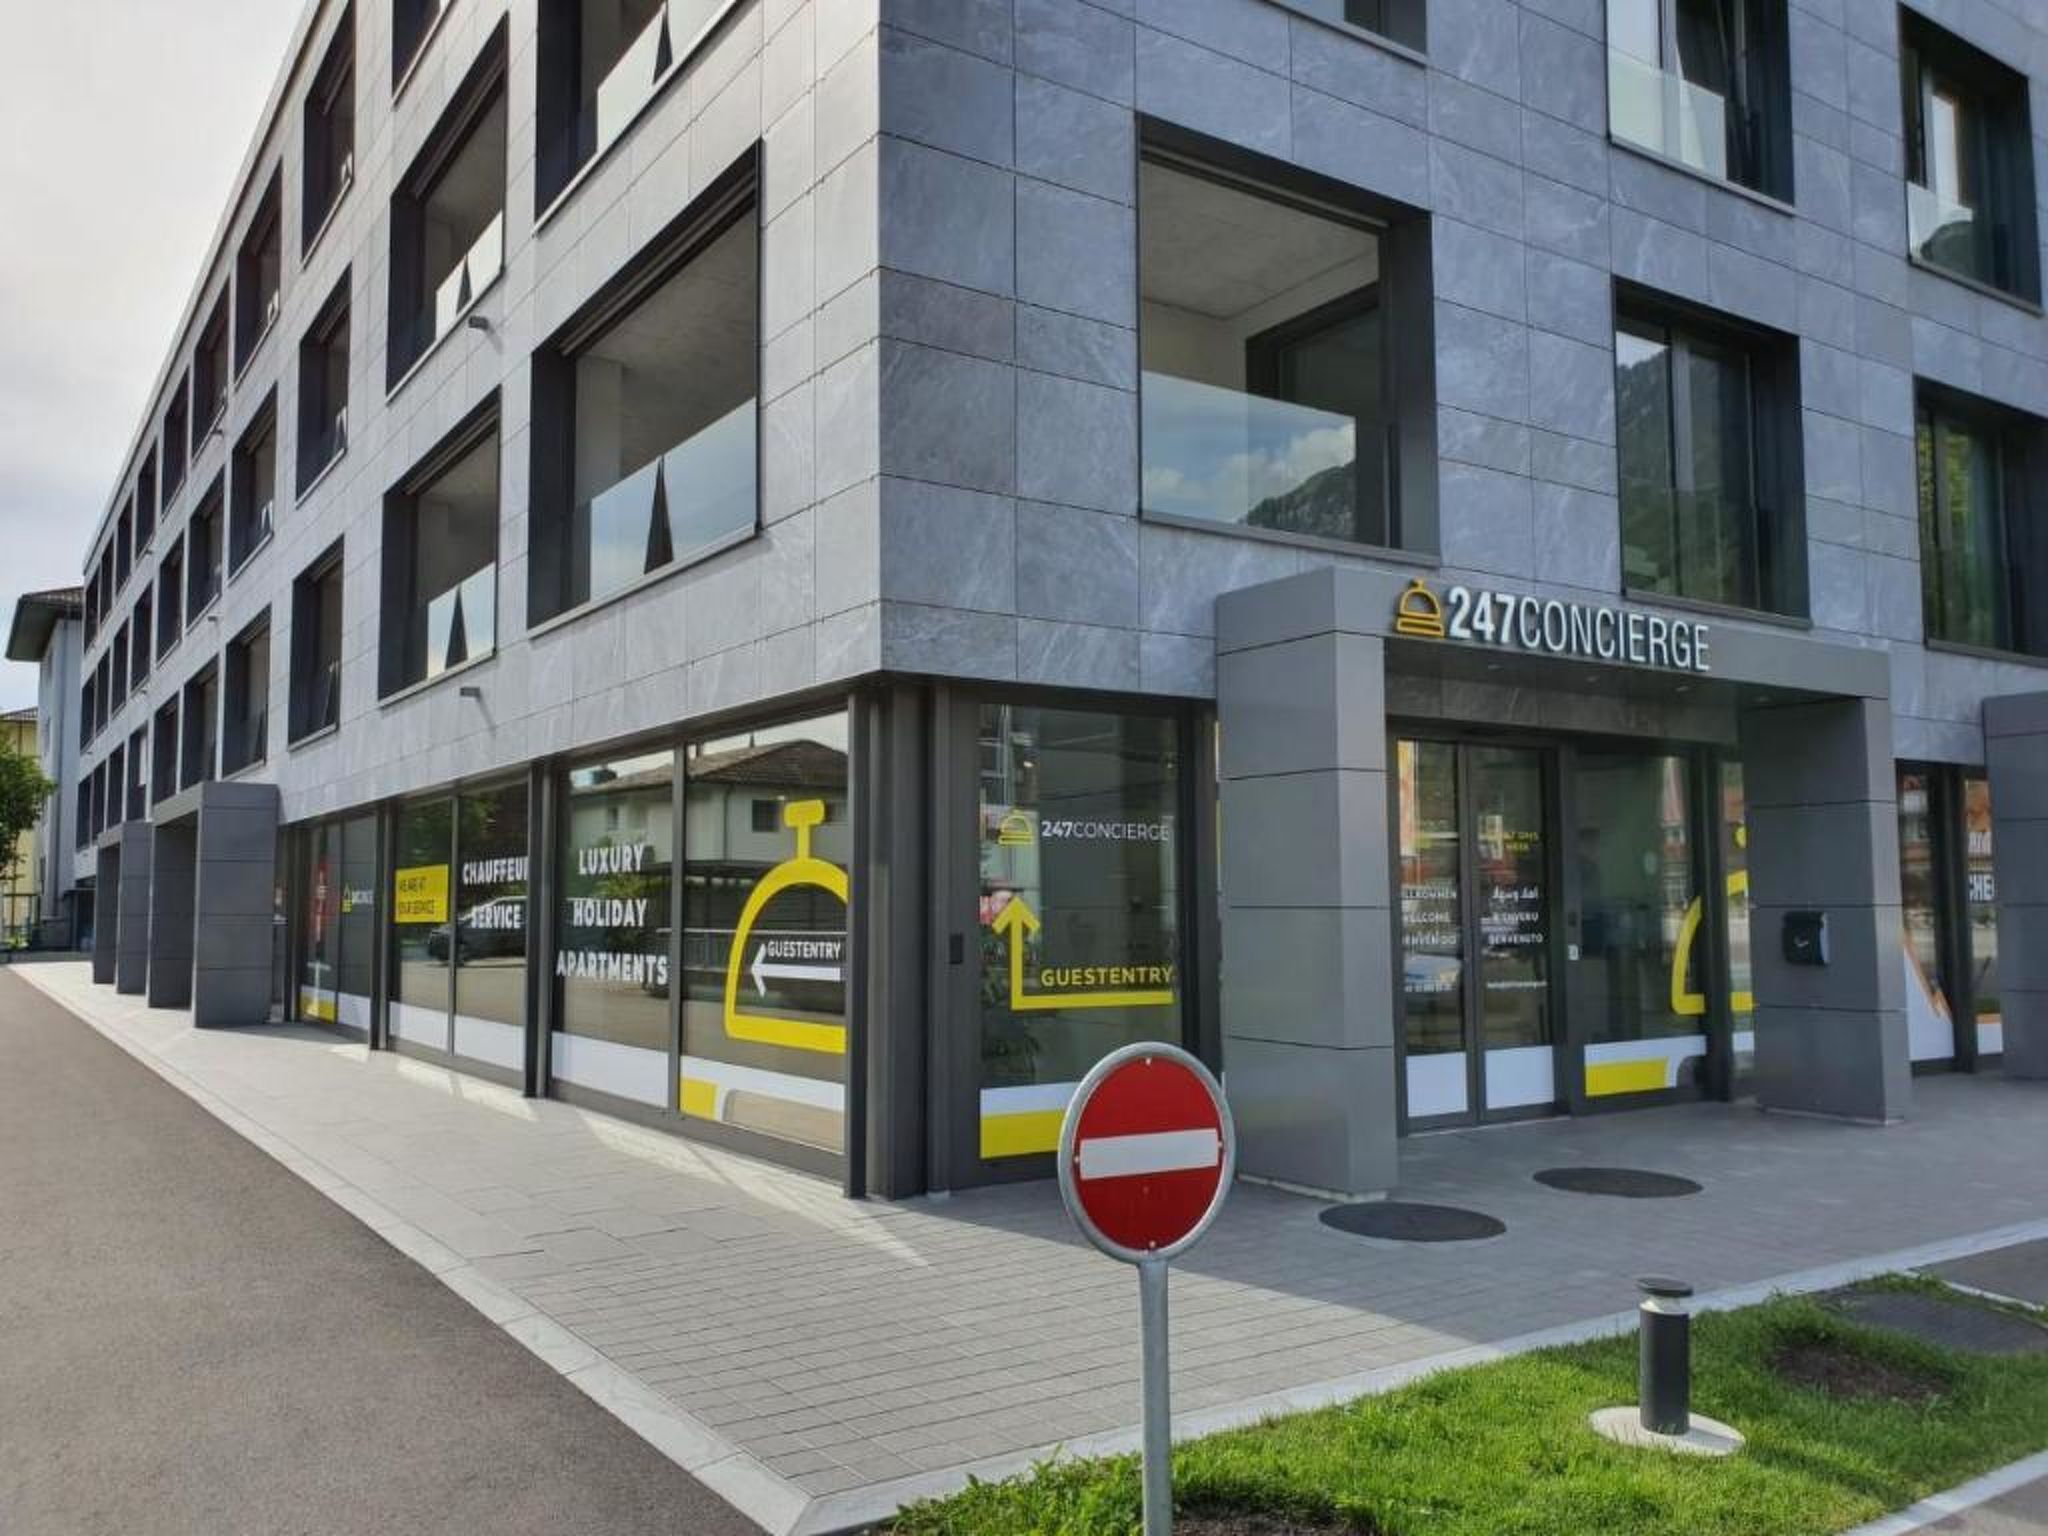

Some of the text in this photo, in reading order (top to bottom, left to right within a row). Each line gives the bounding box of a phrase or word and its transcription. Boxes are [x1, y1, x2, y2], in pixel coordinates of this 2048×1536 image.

[1449, 586, 1710, 671] 247CONCIERGE
[1041, 821, 1169, 841] 247CONCIERGE
[579, 844, 644, 875] LUXURY
[471, 903, 522, 929] SERVICE
[573, 898, 648, 927] HOLIDAY
[766, 940, 842, 959] GUESTENTRY
[556, 950, 670, 985] APARTMENTS
[1041, 965, 1173, 987] GUESTENTRY
